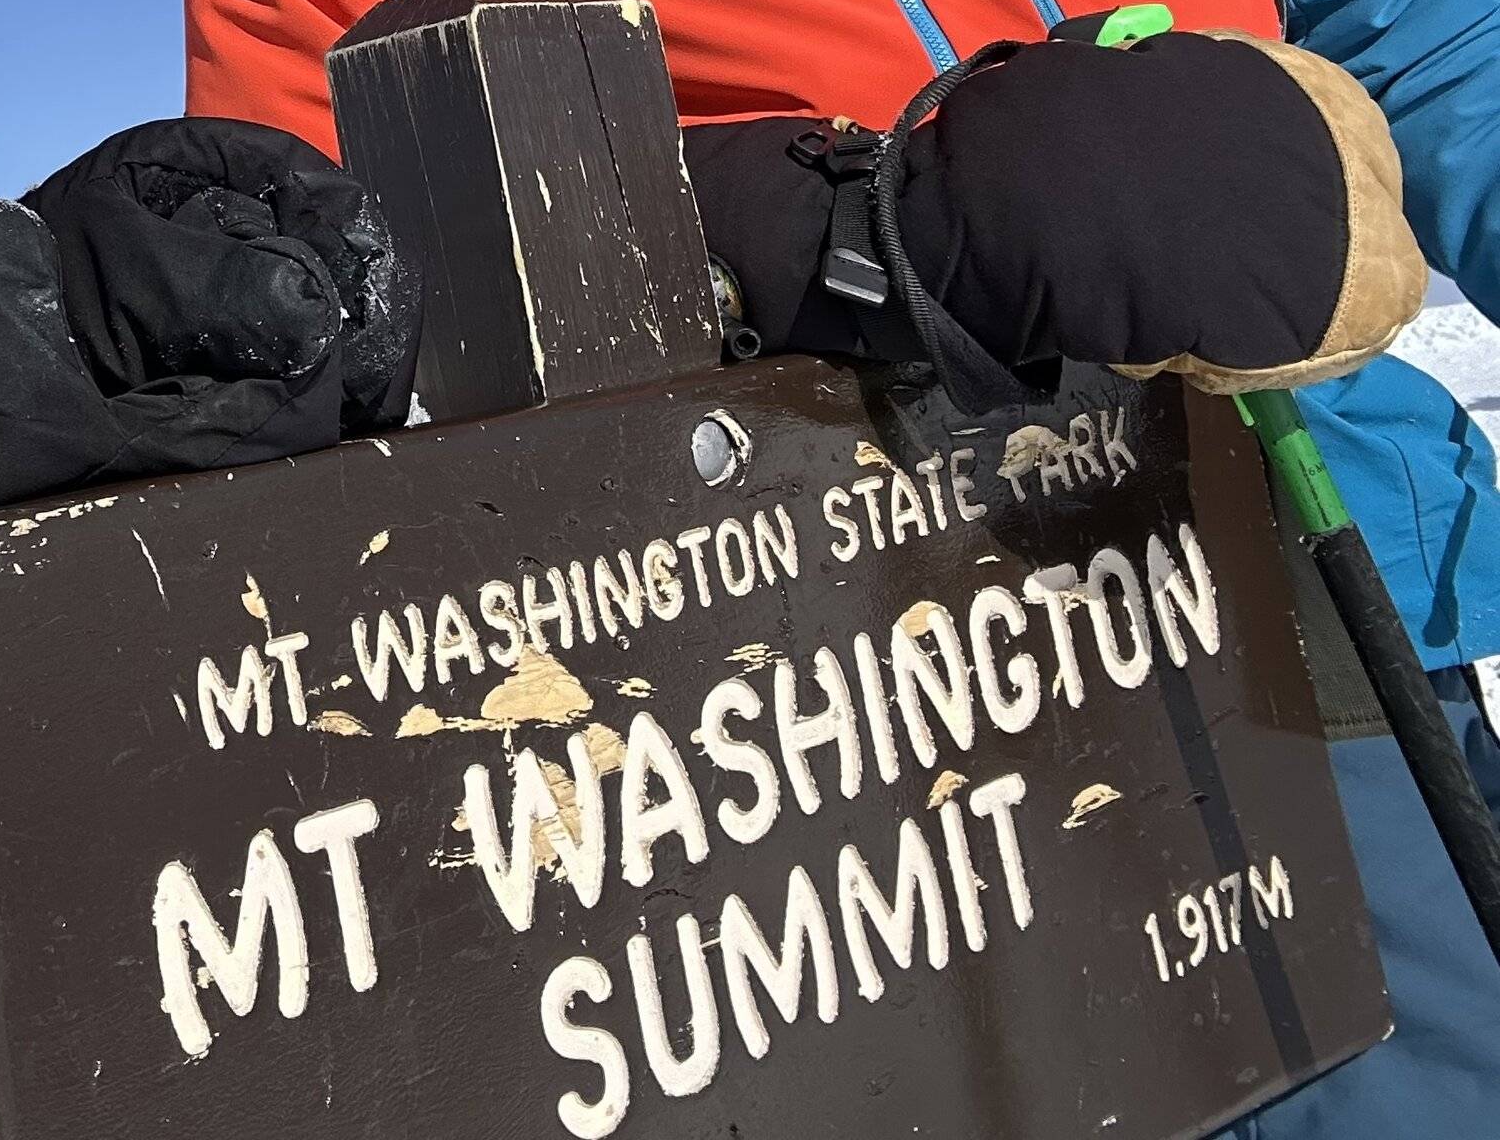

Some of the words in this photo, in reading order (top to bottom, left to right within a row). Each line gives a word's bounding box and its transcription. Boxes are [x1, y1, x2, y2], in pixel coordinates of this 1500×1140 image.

[351, 504, 800, 702] WASHINGTON
[823, 447, 988, 562] STATE
[996, 406, 1138, 503] PARK
[152, 798, 381, 1058] MT
[462, 522, 1222, 933] WASHINGTON
[540, 772, 1036, 1139] SUMMIT
